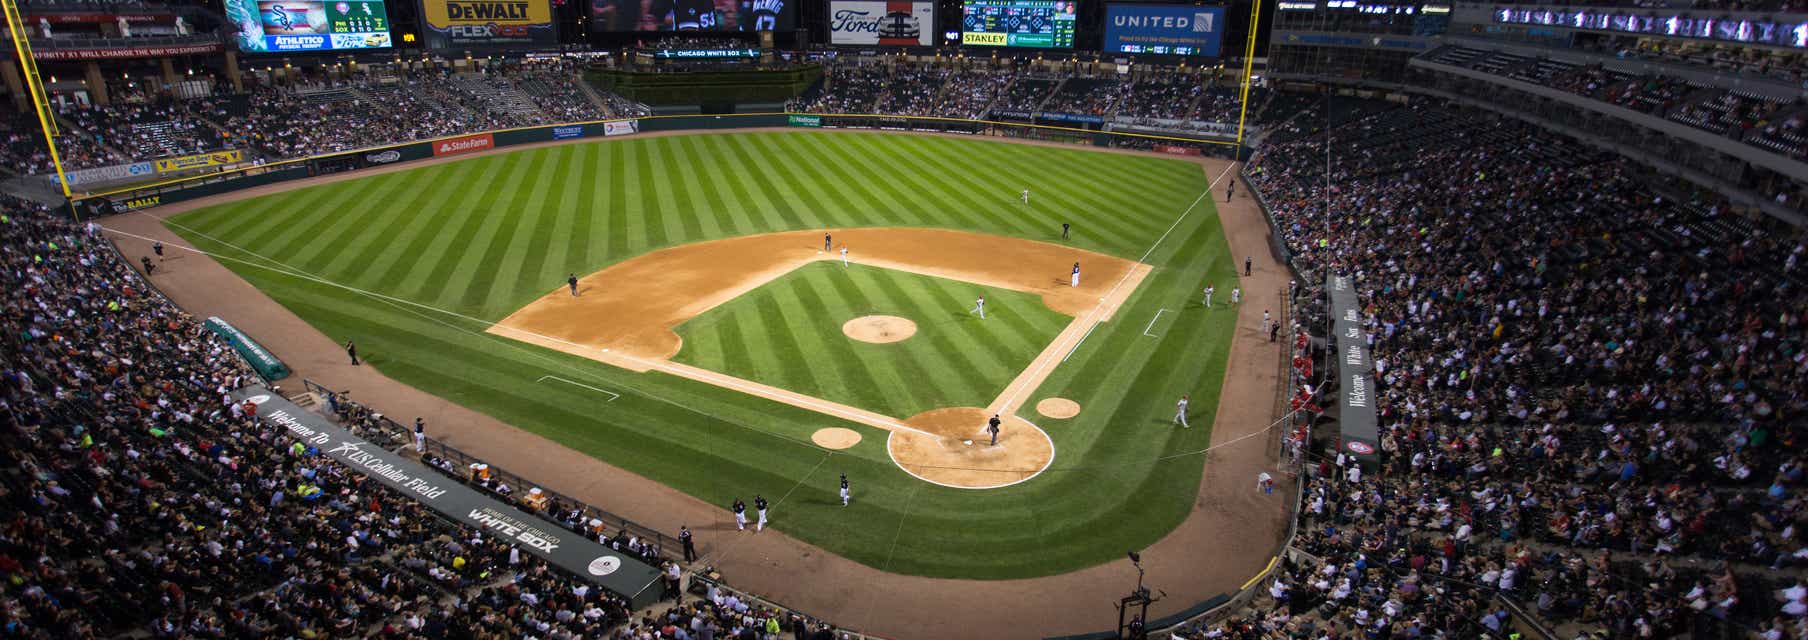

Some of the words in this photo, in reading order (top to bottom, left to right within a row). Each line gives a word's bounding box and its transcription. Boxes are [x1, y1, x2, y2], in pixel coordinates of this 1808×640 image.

[831, 10, 881, 32] Ford
[1114, 16, 1189, 28] UNITED
[964, 34, 1005, 43] STANLEY
[101, 48, 134, 57] CHANGE
[127, 196, 159, 208] RALLY
[1349, 374, 1367, 407] Welcome
[268, 410, 315, 439] Welcome
[310, 432, 329, 445] To
[403, 477, 447, 499] Field
[468, 509, 522, 536] WHITE
[516, 532, 559, 553] SOX
[527, 527, 561, 544] CHICAGO
